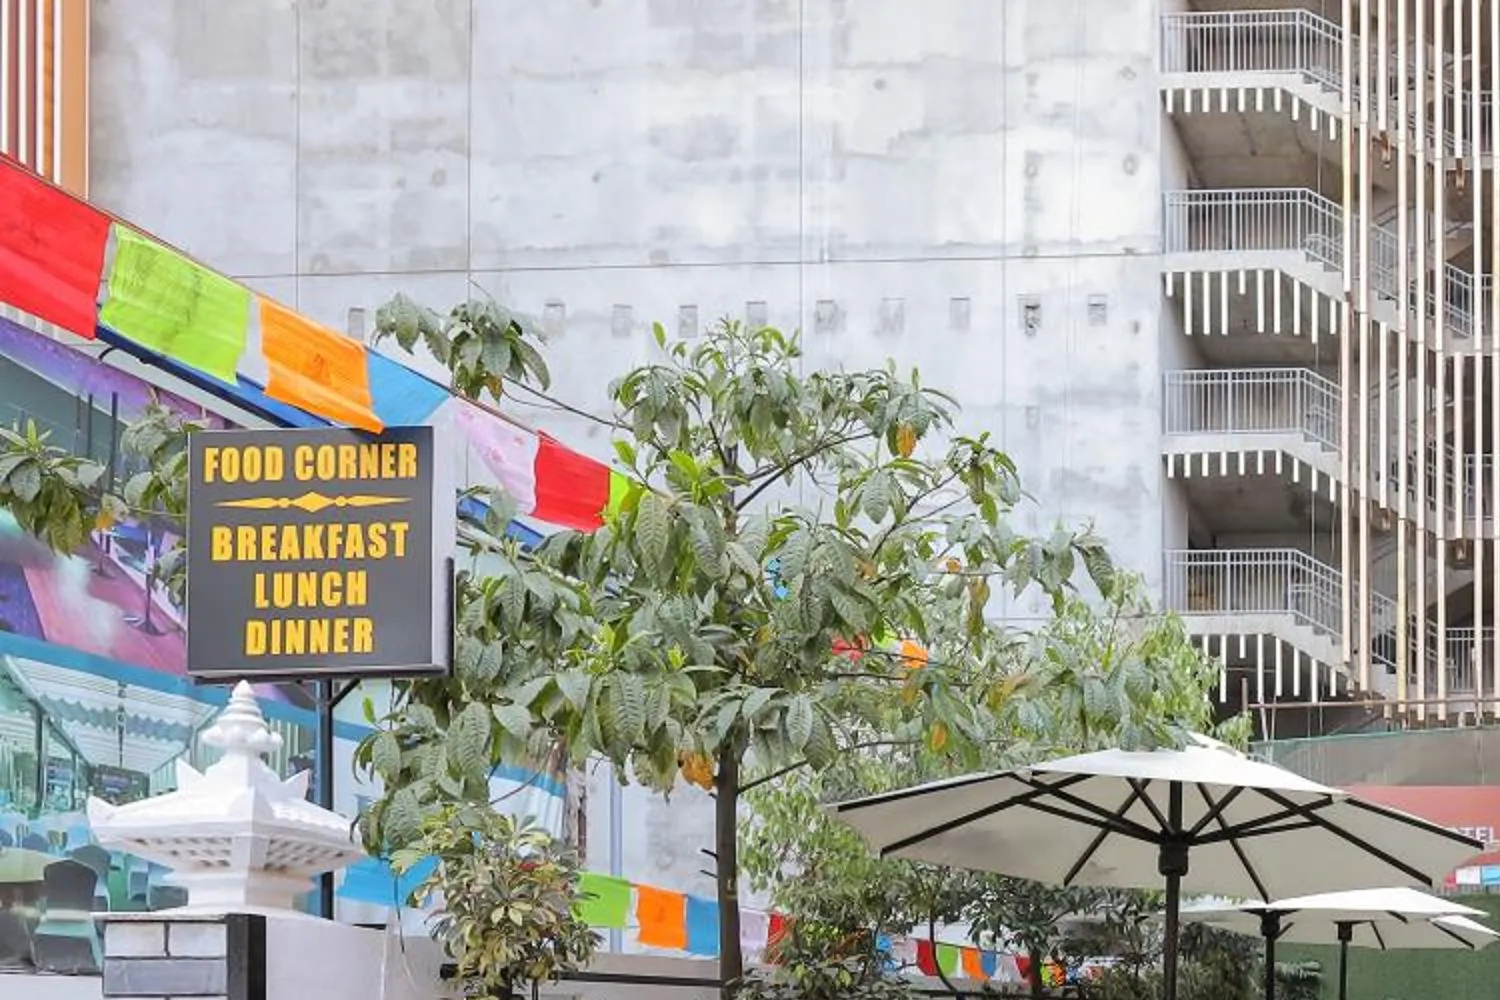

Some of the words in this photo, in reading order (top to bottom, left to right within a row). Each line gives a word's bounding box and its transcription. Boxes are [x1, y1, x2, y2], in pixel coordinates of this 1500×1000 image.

[203, 446, 284, 483] FOOD
[294, 443, 418, 481] CORNER
[211, 521, 409, 561] BREAKFAST
[254, 570, 367, 608] LUNCH
[245, 617, 374, 656] DINNER
